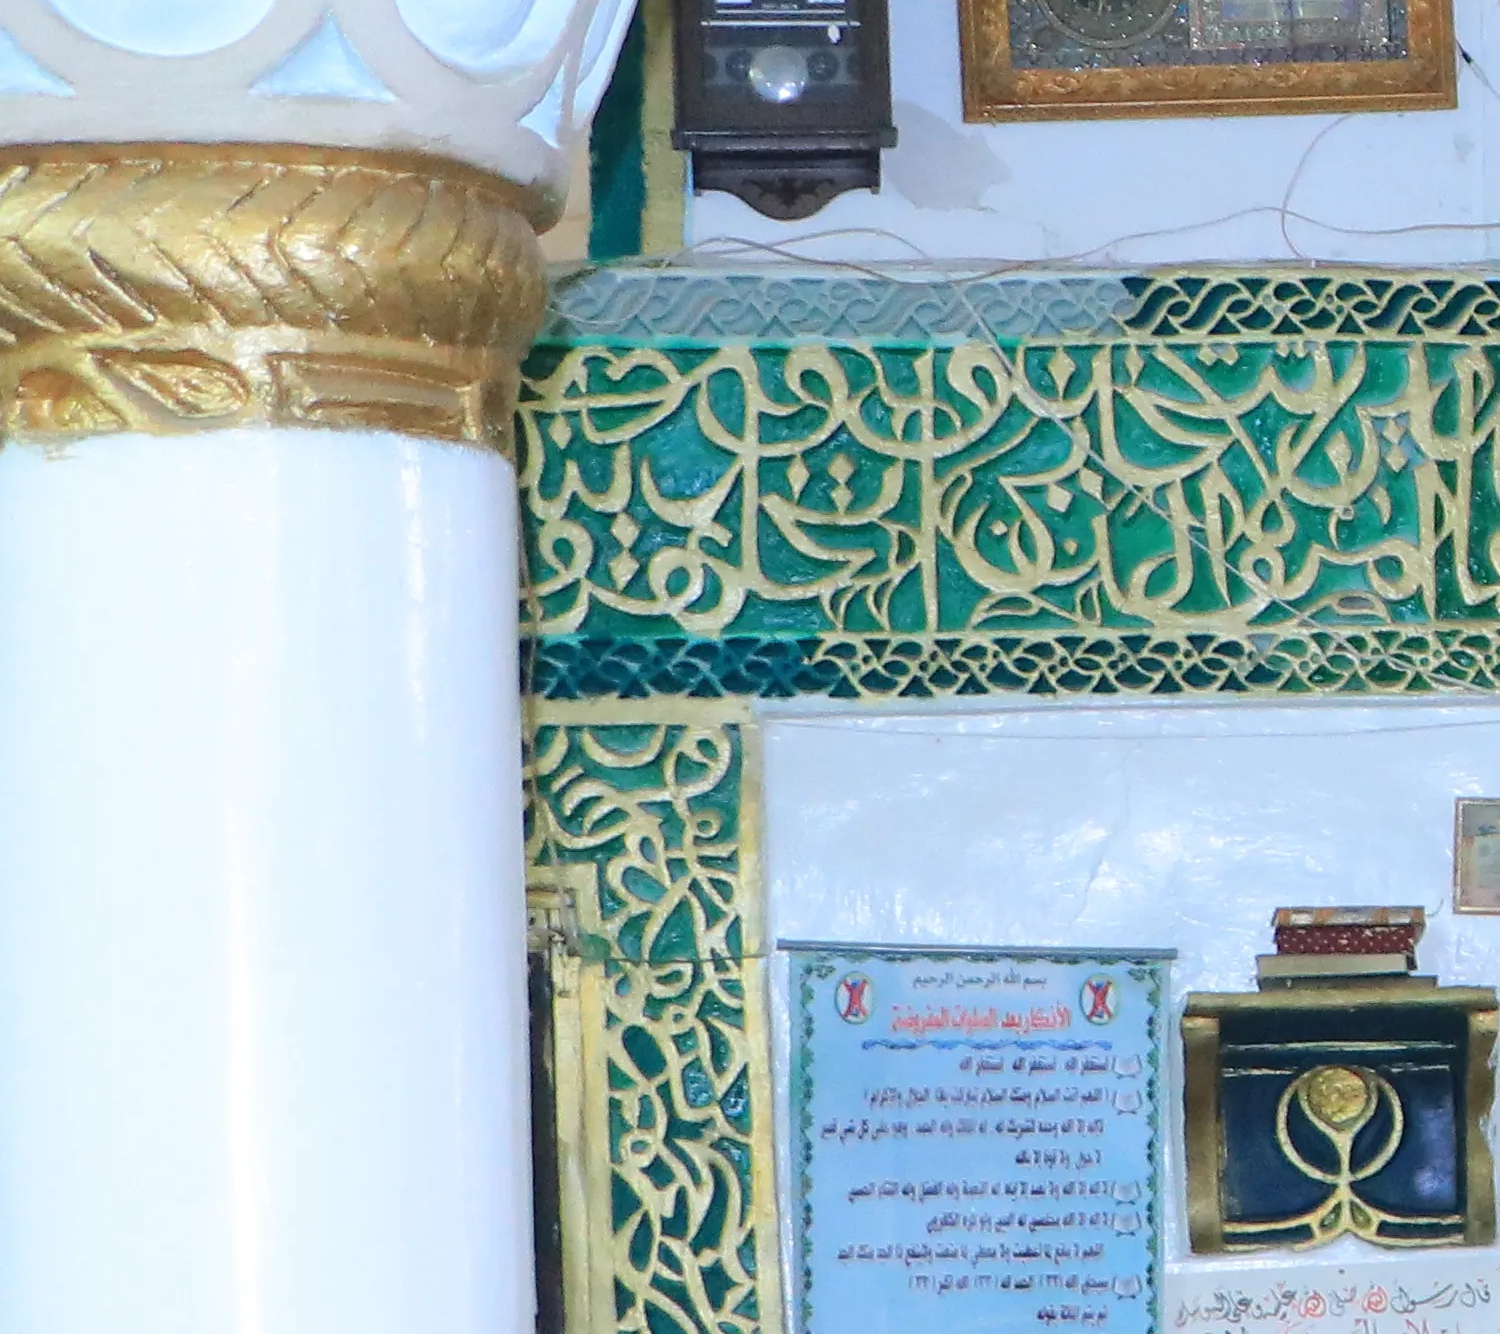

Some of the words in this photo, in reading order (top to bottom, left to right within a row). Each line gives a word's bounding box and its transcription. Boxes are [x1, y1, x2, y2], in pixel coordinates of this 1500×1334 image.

[913, 970, 954, 989] الرحيم
[956, 970, 1001, 990] الرحمن
[1002, 967, 1022, 985] الله
[1022, 975, 1048, 989] بسم
